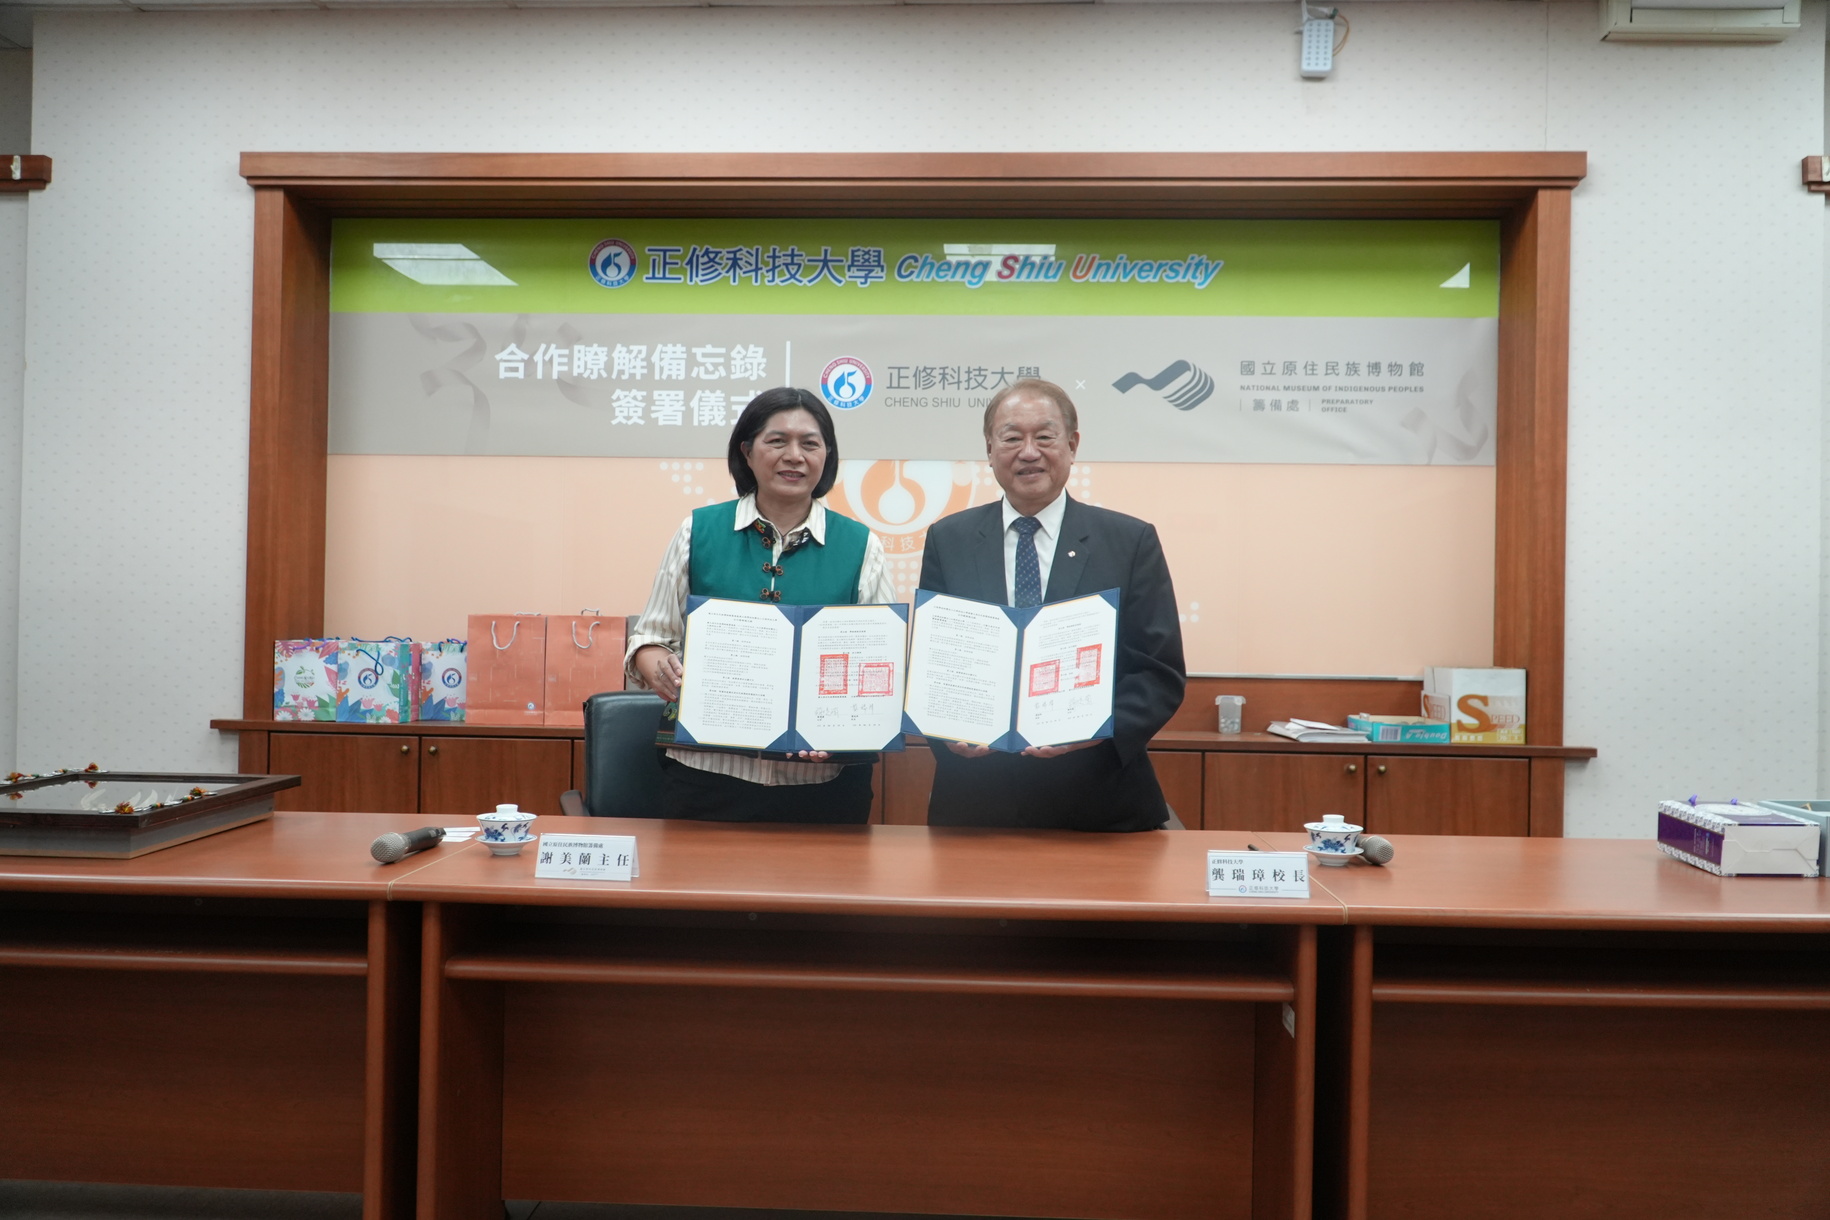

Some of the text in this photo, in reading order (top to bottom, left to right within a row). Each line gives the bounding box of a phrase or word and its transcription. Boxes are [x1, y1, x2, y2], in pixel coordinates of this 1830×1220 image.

[644, 247, 885, 286] 正修科技大學
[896, 254, 1222, 288] Cheng Shiu University
[494, 343, 767, 381] 合作瞭解備忘錄
[1240, 361, 1425, 377] 國立原住民族博物館
[1335, 385, 1386, 393] INDIGENOUS
[884, 397, 928, 408] CHENG
[932, 397, 961, 408] SHIU
[1252, 398, 1300, 412] 籌備處
[1415, 730, 1448, 740] Double
[540, 851, 630, 867] 謝美蘭主任
[1211, 867, 1305, 883] 龔瑞璋校長
